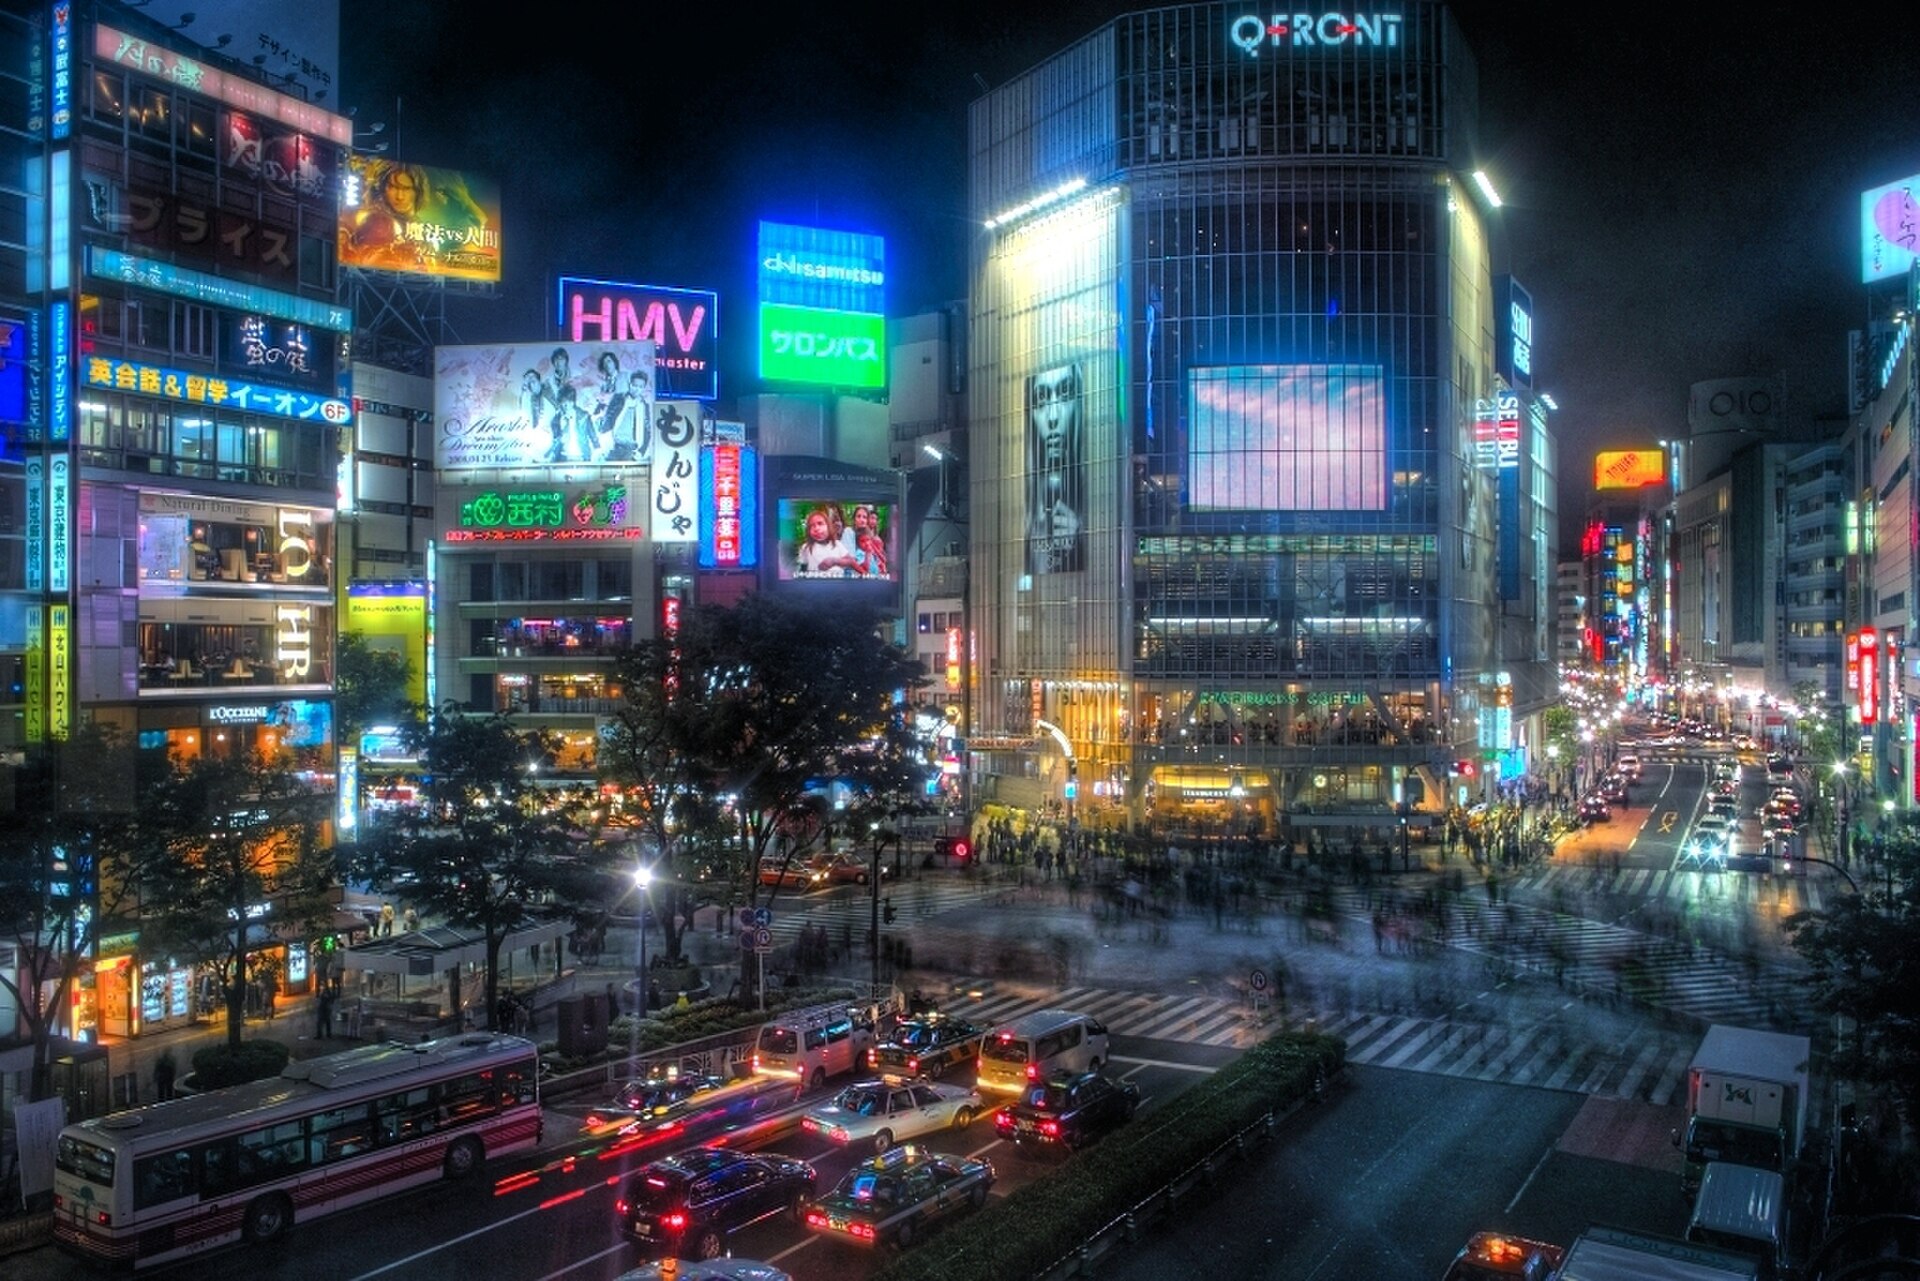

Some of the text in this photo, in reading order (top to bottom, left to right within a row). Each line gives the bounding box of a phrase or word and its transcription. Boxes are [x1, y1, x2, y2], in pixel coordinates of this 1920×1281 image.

[1231, 12, 1403, 57] QFRONT
[572, 293, 705, 352] HMV
[770, 330, 878, 362] サロンパス
[1498, 397, 1518, 467] SEIBU
[656, 404, 694, 535] もんじゃ
